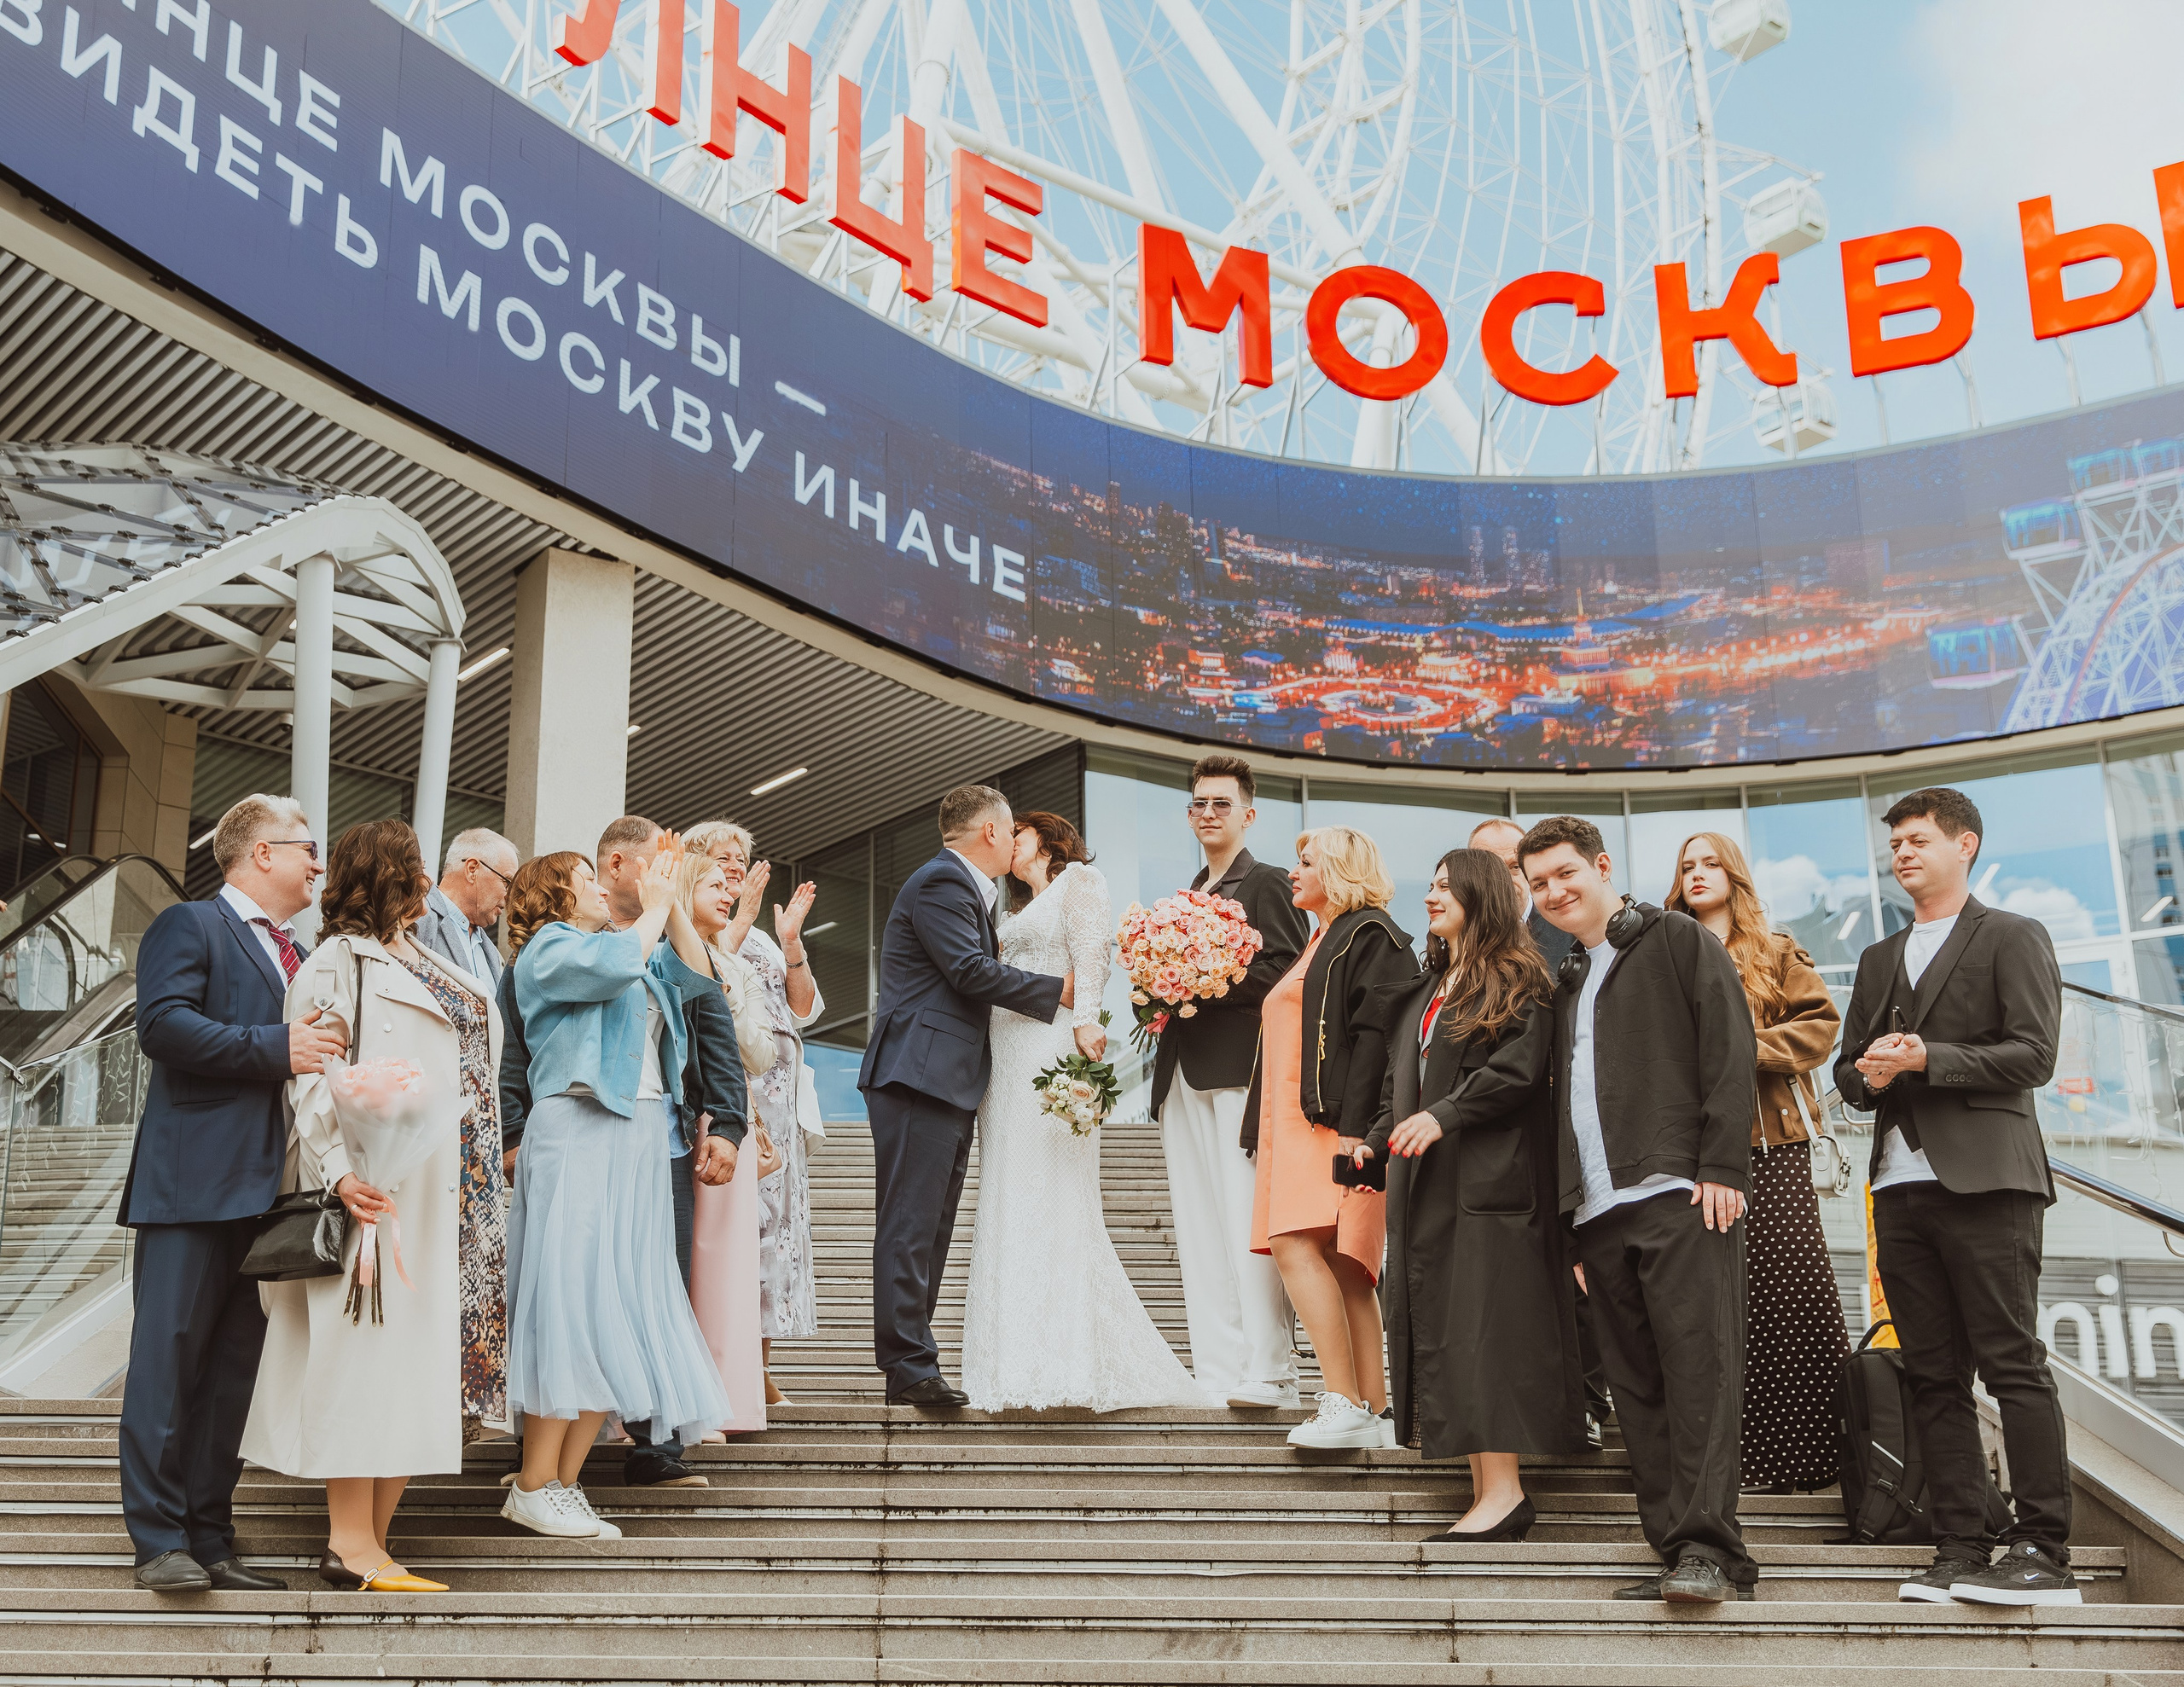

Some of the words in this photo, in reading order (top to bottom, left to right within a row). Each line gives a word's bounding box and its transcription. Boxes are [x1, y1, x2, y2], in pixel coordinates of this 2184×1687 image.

[121, 0, 340, 153] НЦЕ
[380, 127, 741, 388] МОСКВЫ
[1137, 160, 2184, 405] МОСКВЫ
[416, 243, 764, 473] МОСКВУ
[795, 450, 1026, 602] ИНАЧЕ
